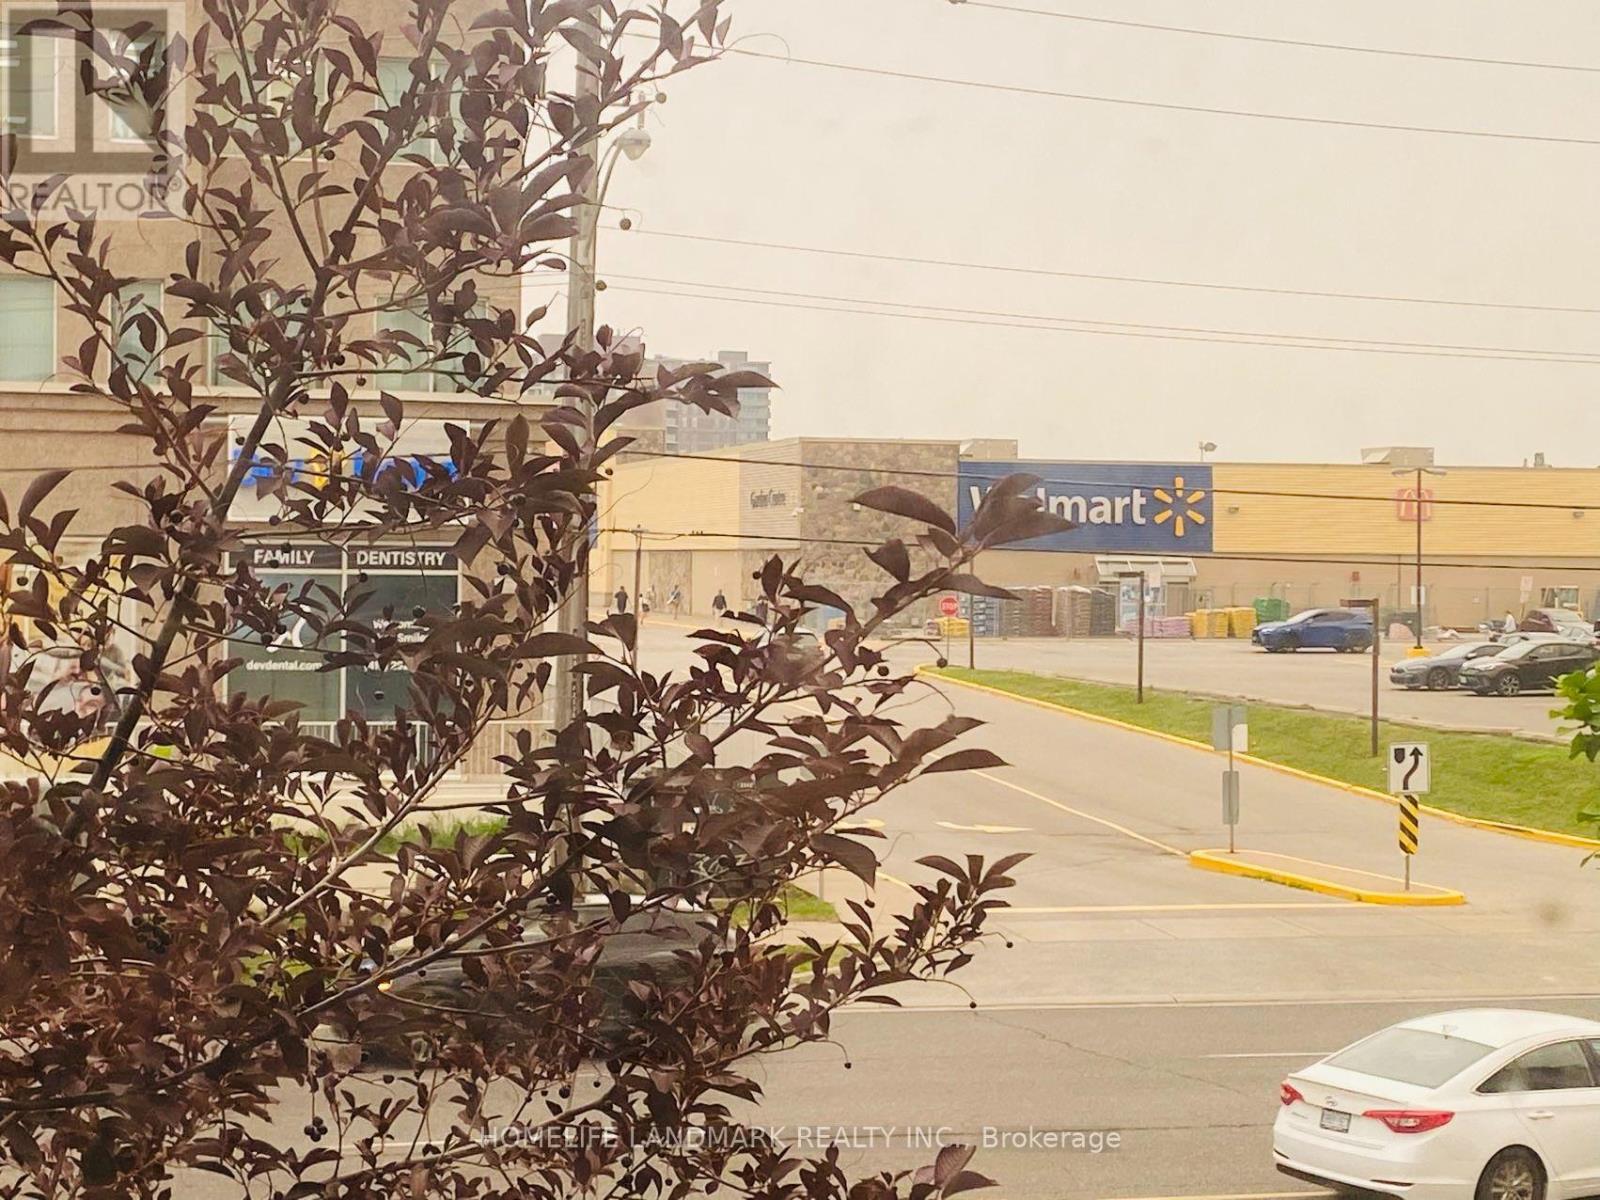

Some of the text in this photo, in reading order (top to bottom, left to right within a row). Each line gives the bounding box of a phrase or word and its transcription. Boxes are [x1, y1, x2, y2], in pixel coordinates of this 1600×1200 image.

[969, 486, 1147, 525] lmart
[253, 548, 316, 565] FAMILY
[356, 550, 447, 567] DENTISTRY
[245, 659, 323, 671] devdental.com
